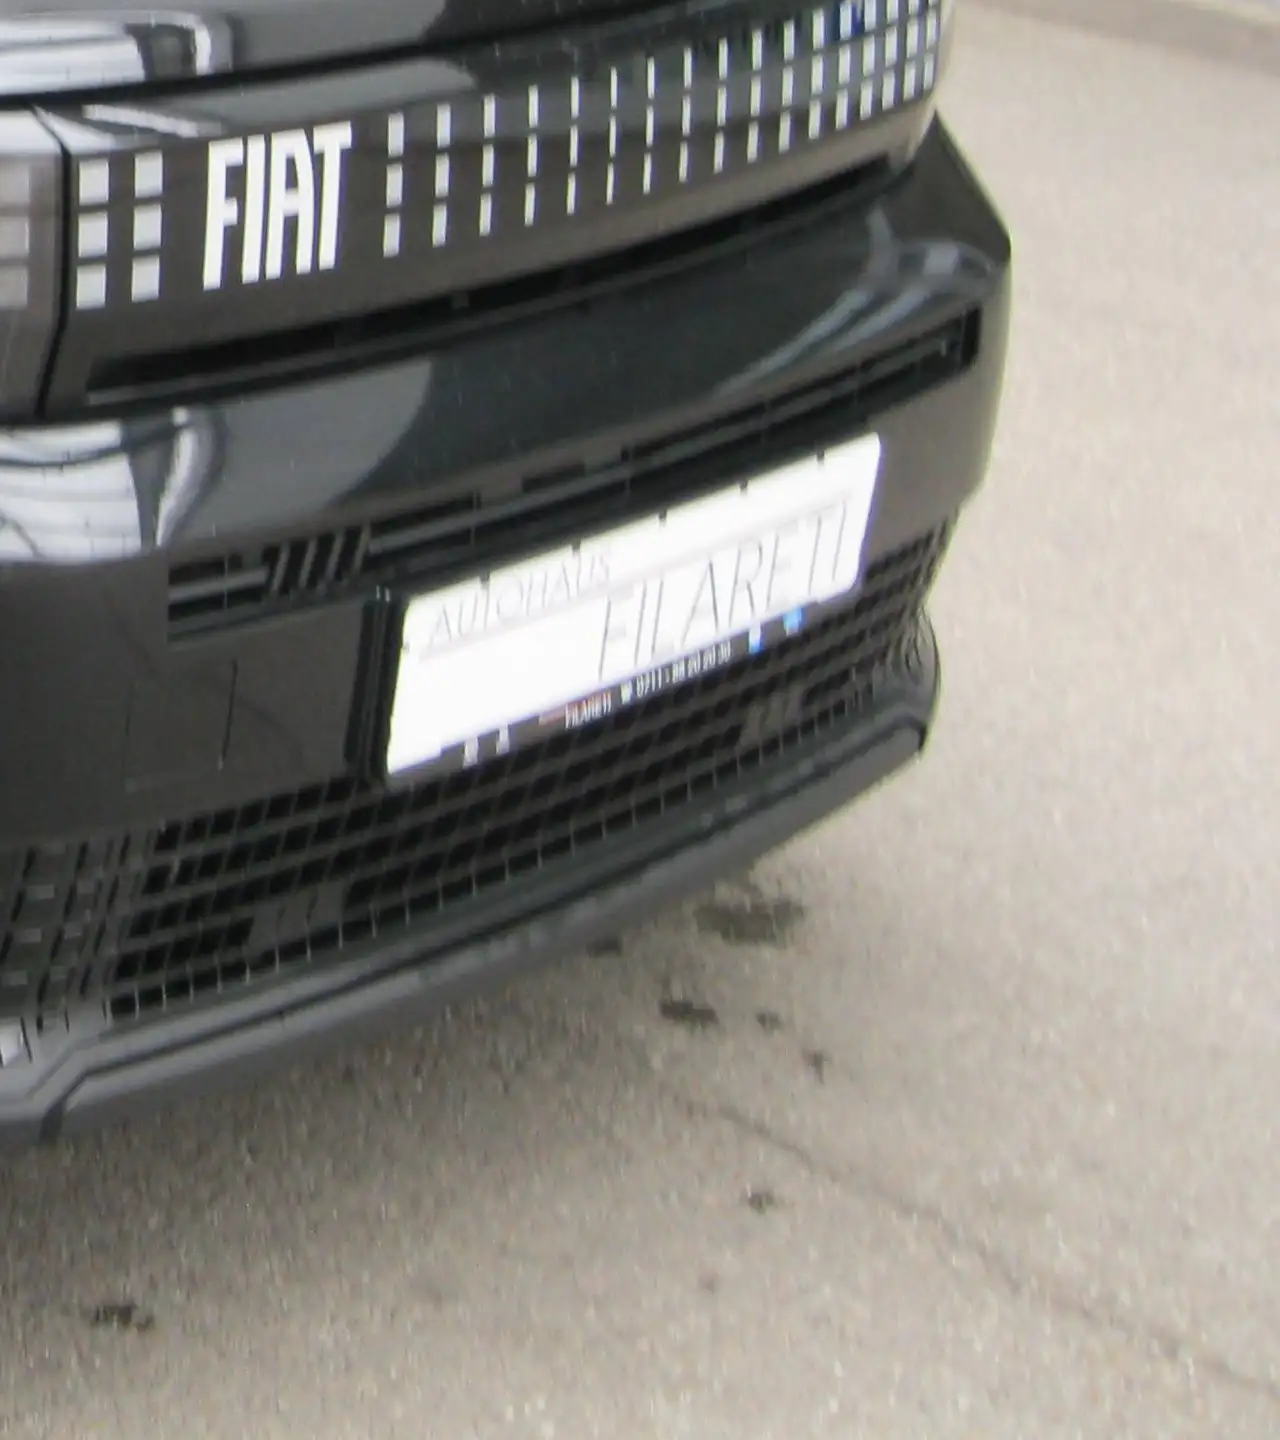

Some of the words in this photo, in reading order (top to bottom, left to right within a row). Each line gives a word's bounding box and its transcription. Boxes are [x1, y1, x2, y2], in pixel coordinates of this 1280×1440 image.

[203, 120, 352, 291] FIAT
[427, 552, 613, 645] AUTOHAUS
[598, 498, 850, 682] FILARETI
